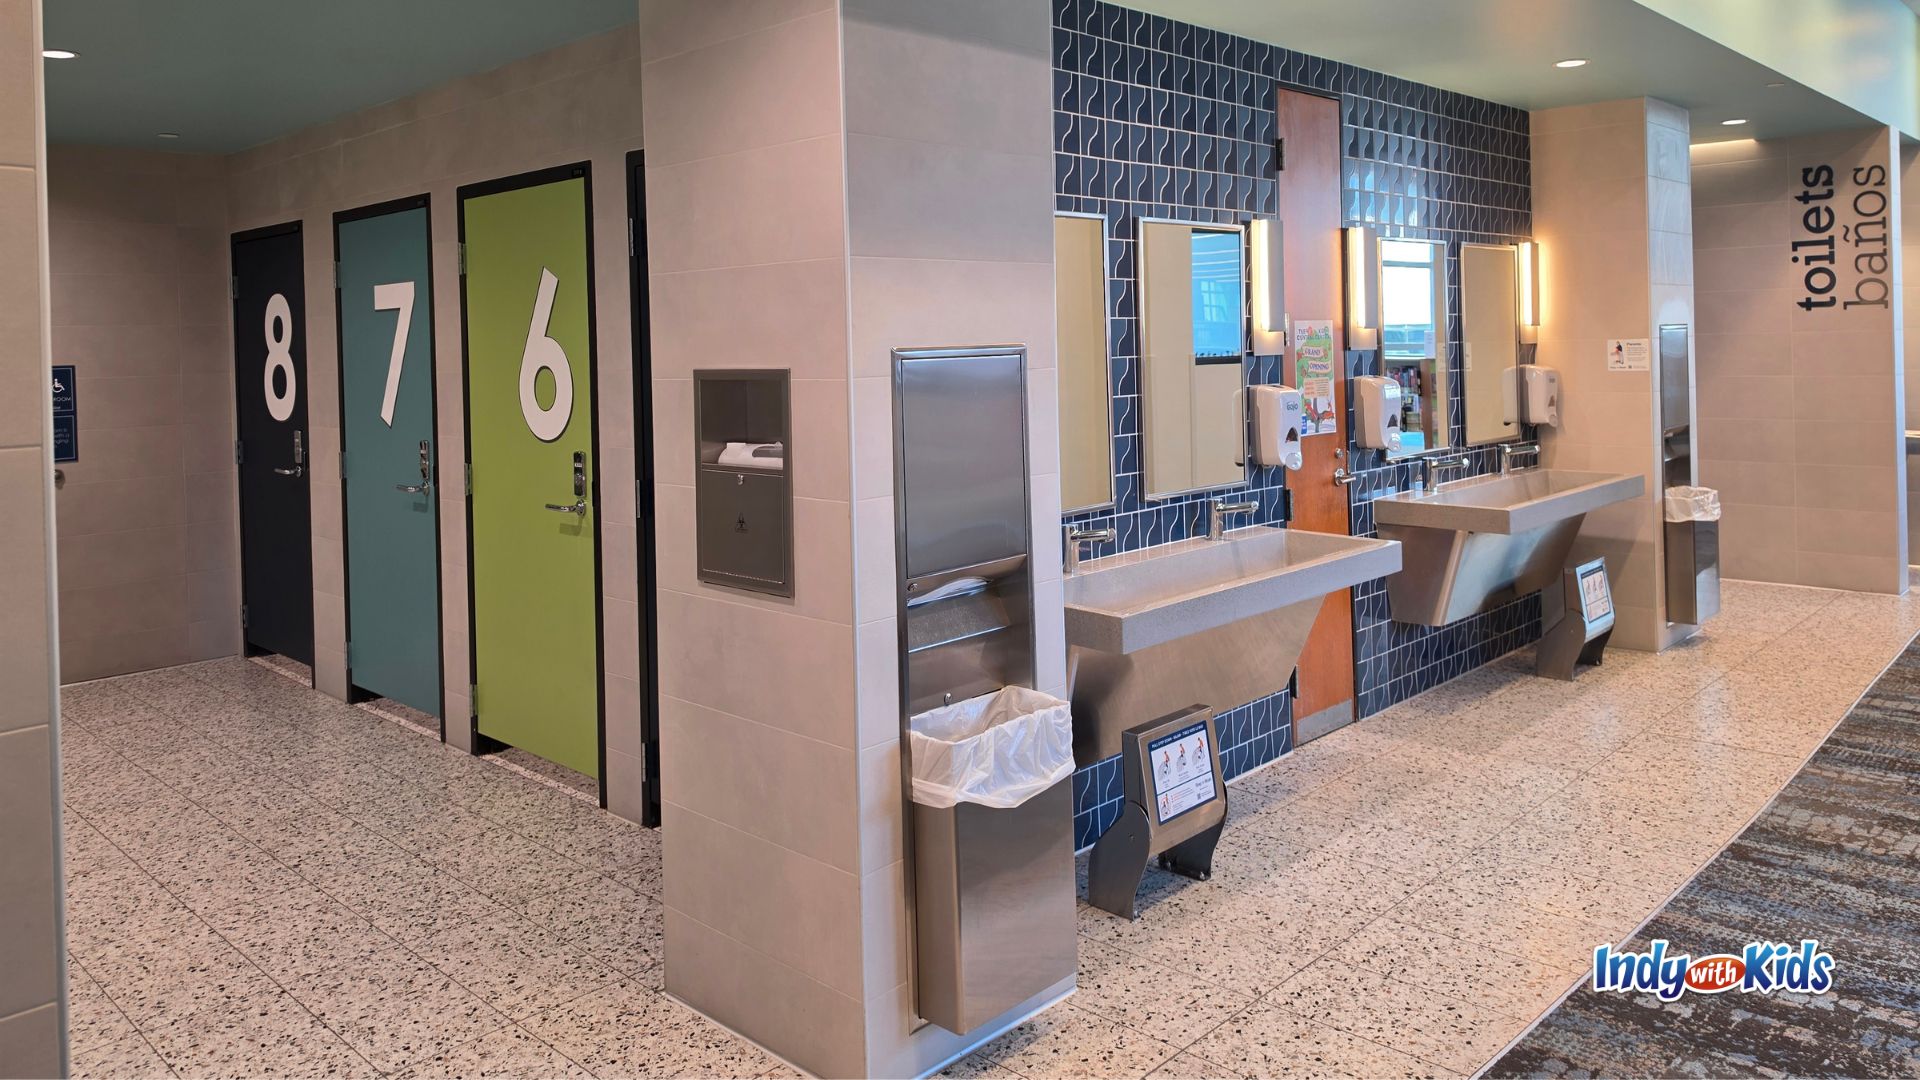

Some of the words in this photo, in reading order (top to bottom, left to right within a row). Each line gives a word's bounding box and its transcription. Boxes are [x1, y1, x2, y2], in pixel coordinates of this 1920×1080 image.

[1791, 164, 1837, 312] toilets
[1842, 164, 1889, 310] baños
[264, 293, 297, 422] 8
[374, 281, 416, 429] 7
[519, 267, 574, 442] 6
